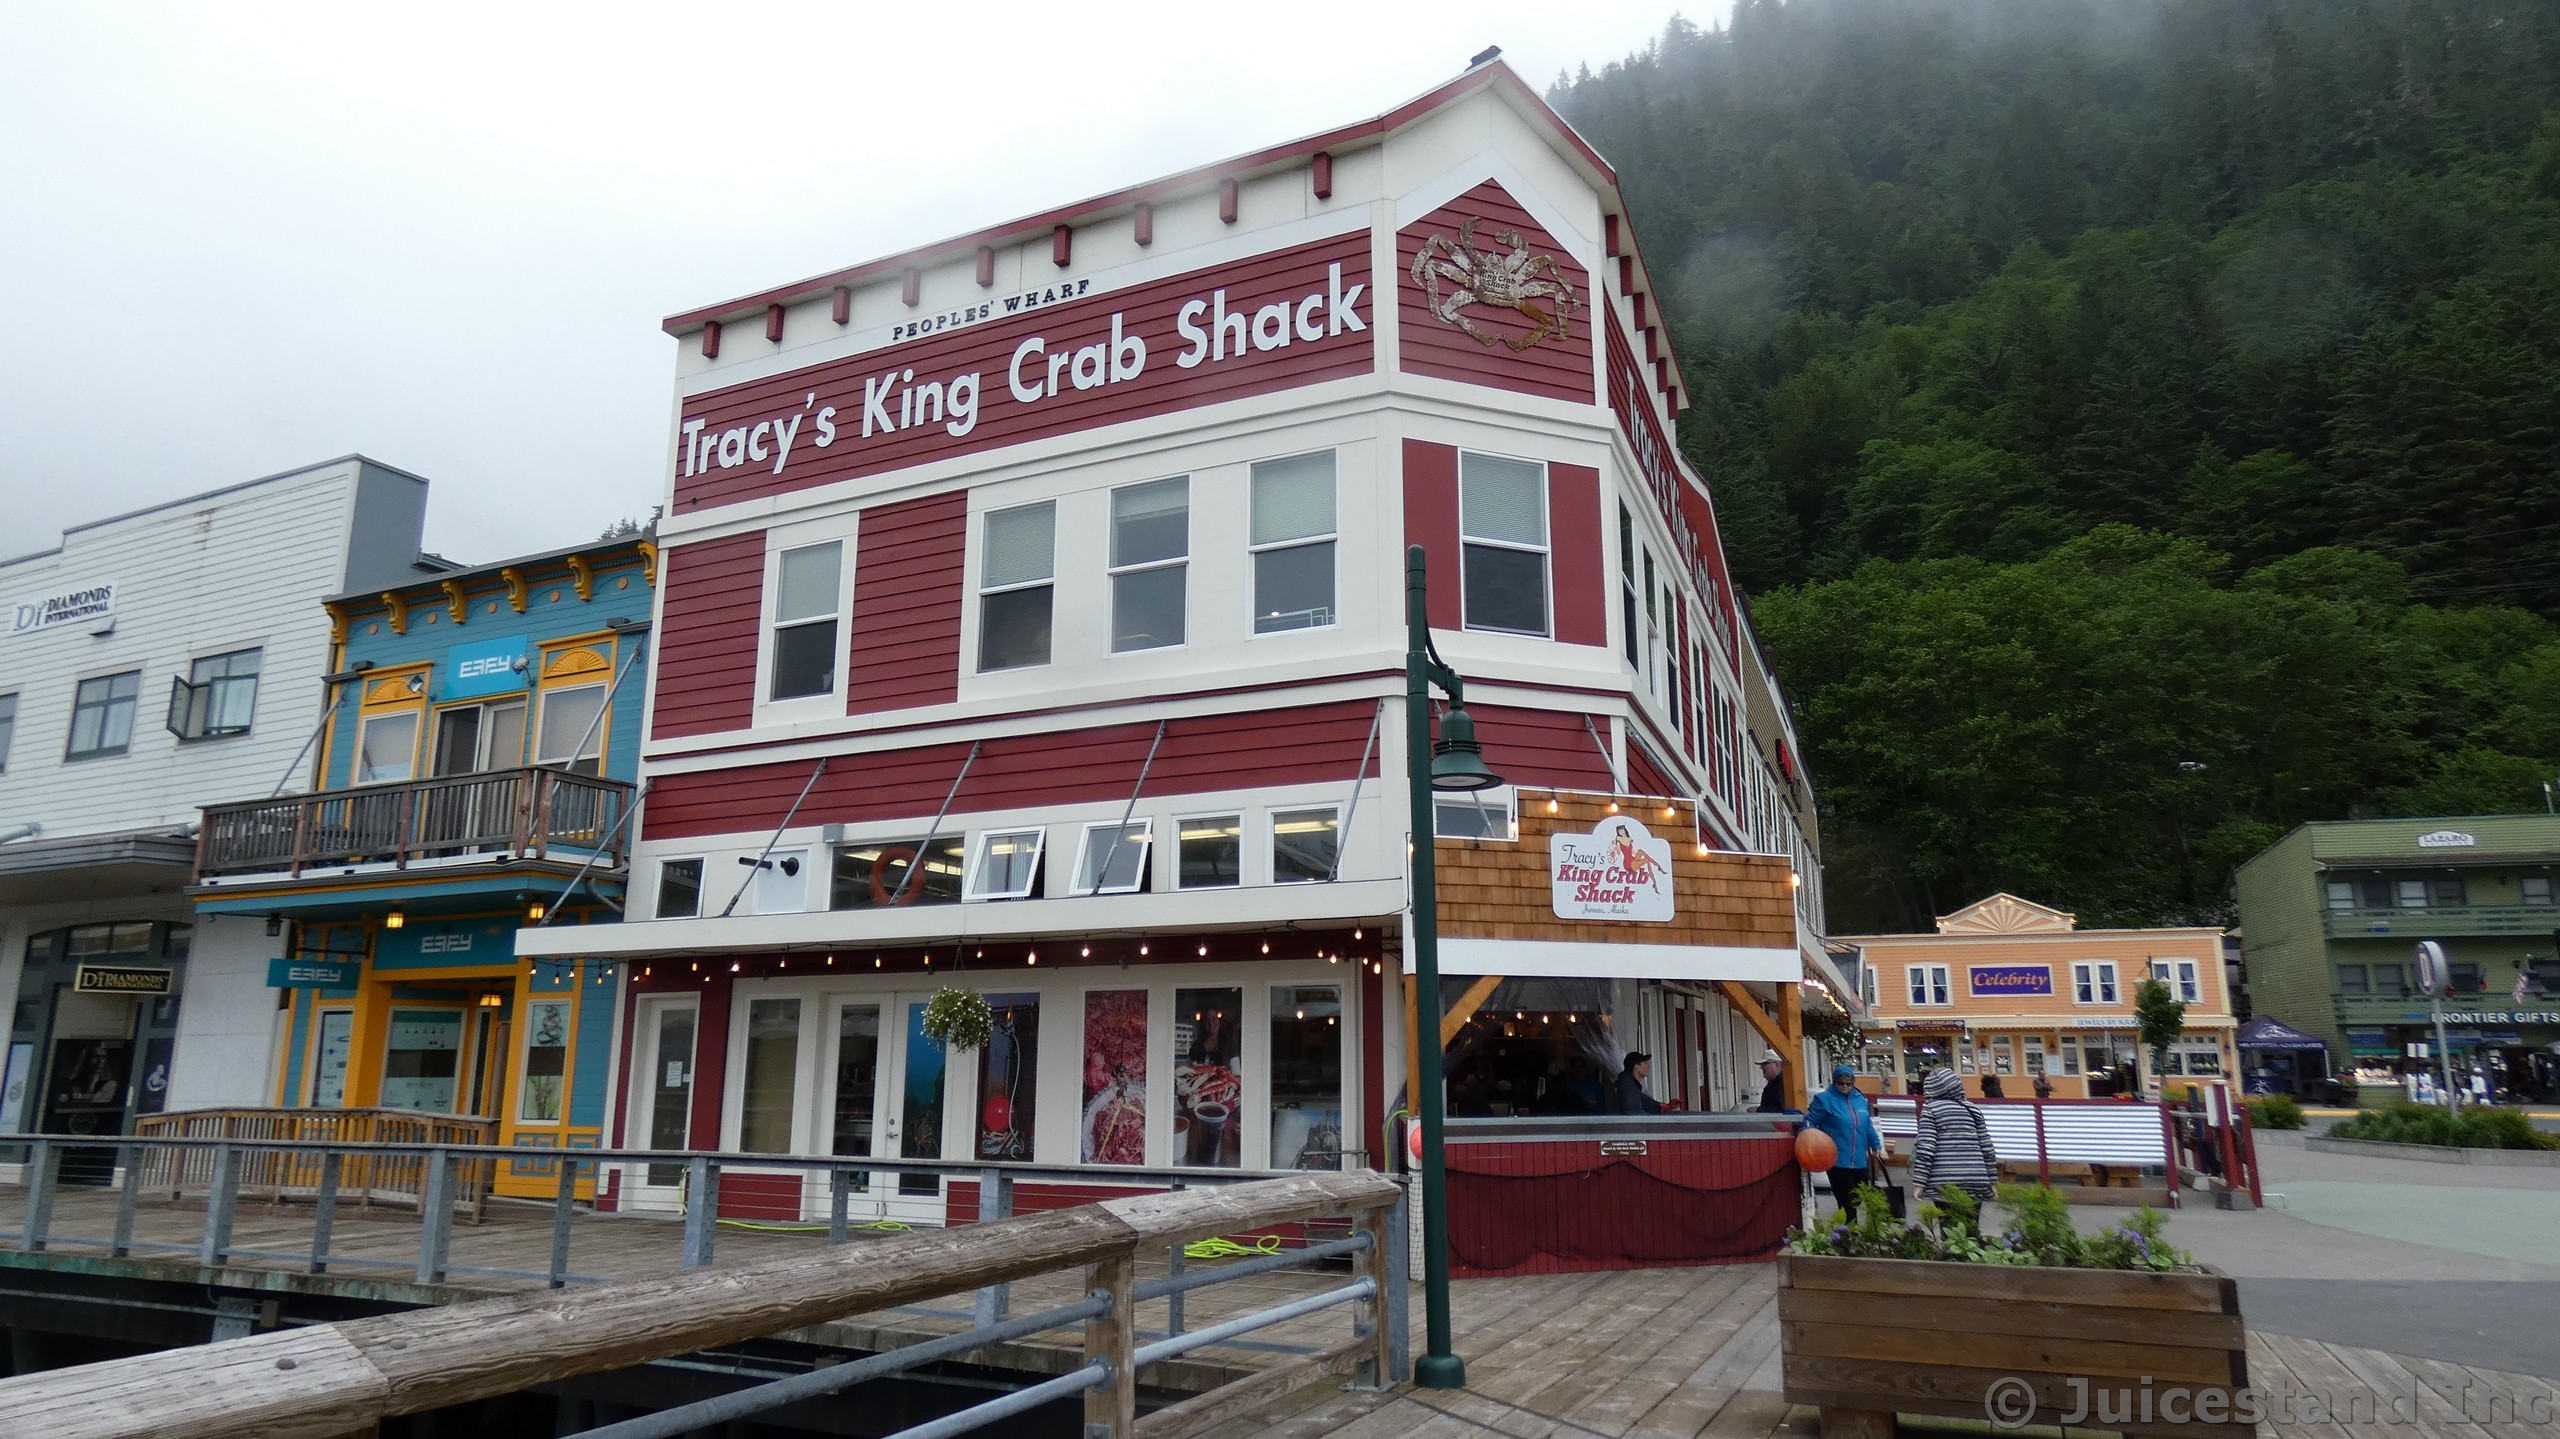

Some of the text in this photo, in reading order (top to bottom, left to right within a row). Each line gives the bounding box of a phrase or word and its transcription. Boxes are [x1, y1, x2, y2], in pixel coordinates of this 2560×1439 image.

[893, 279, 1091, 340] PEOPLES' WHARF
[683, 263, 1367, 477] Tracy's King Crab Shack
[47, 585, 112, 612] DIAMONDS
[45, 602, 108, 624] INTERNATIONAL
[1561, 844, 1605, 869] Tracy's
[1557, 864, 1649, 887] King Crab
[1574, 883, 1635, 904] Shack
[1973, 972, 2048, 991] Celebrity
[2514, 1012, 2560, 1023] GIFTS
